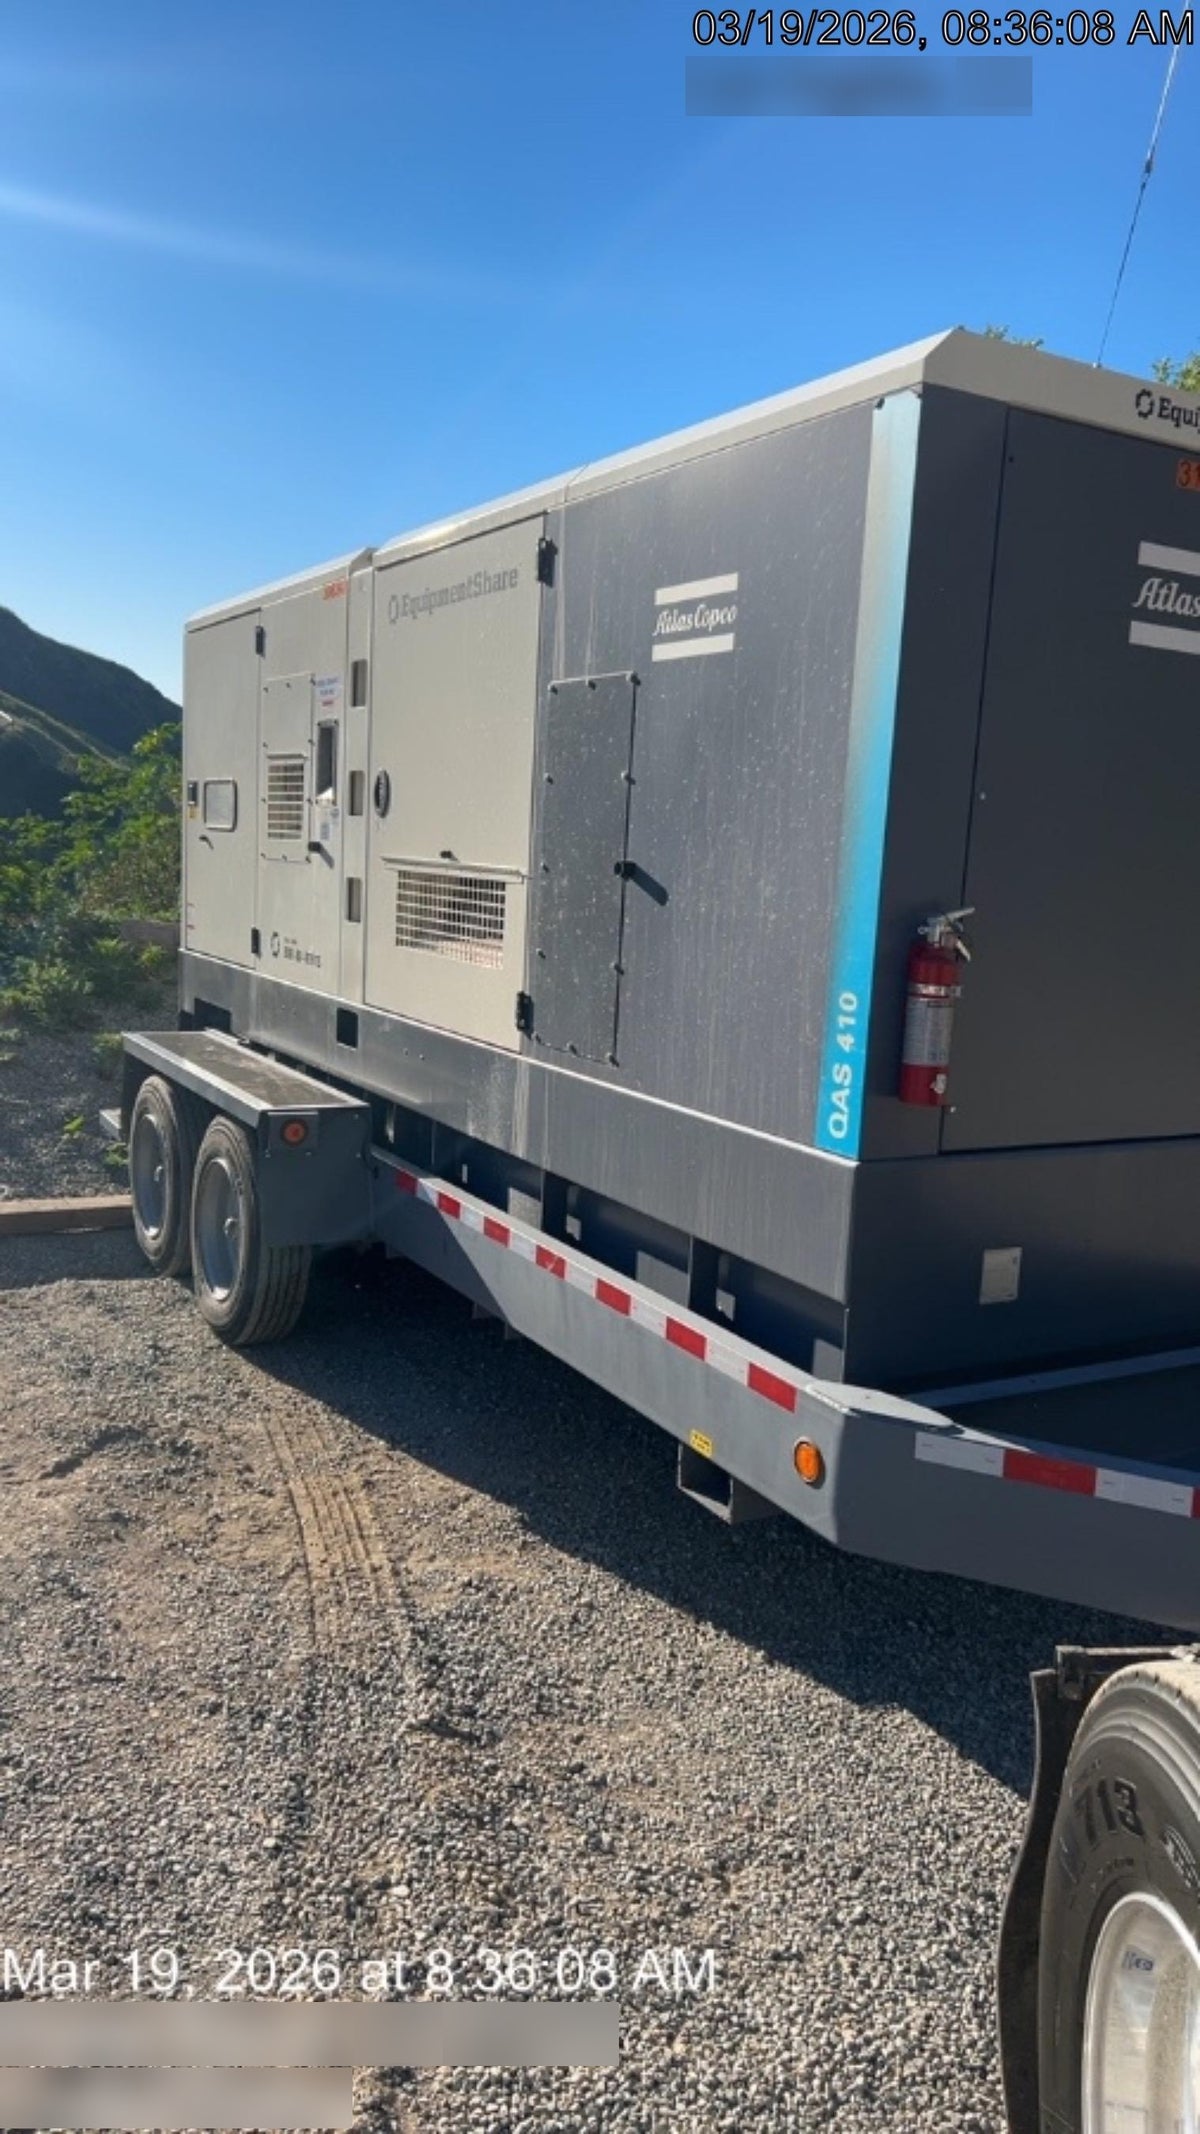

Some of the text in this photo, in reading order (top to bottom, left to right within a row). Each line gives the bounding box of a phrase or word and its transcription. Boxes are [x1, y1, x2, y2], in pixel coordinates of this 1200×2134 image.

[1158, 396, 1200, 434] Equi
[401, 567, 519, 620] EquipmentShare
[652, 603, 738, 636] Atlas Copco
[828, 991, 858, 1139] QAS 410
